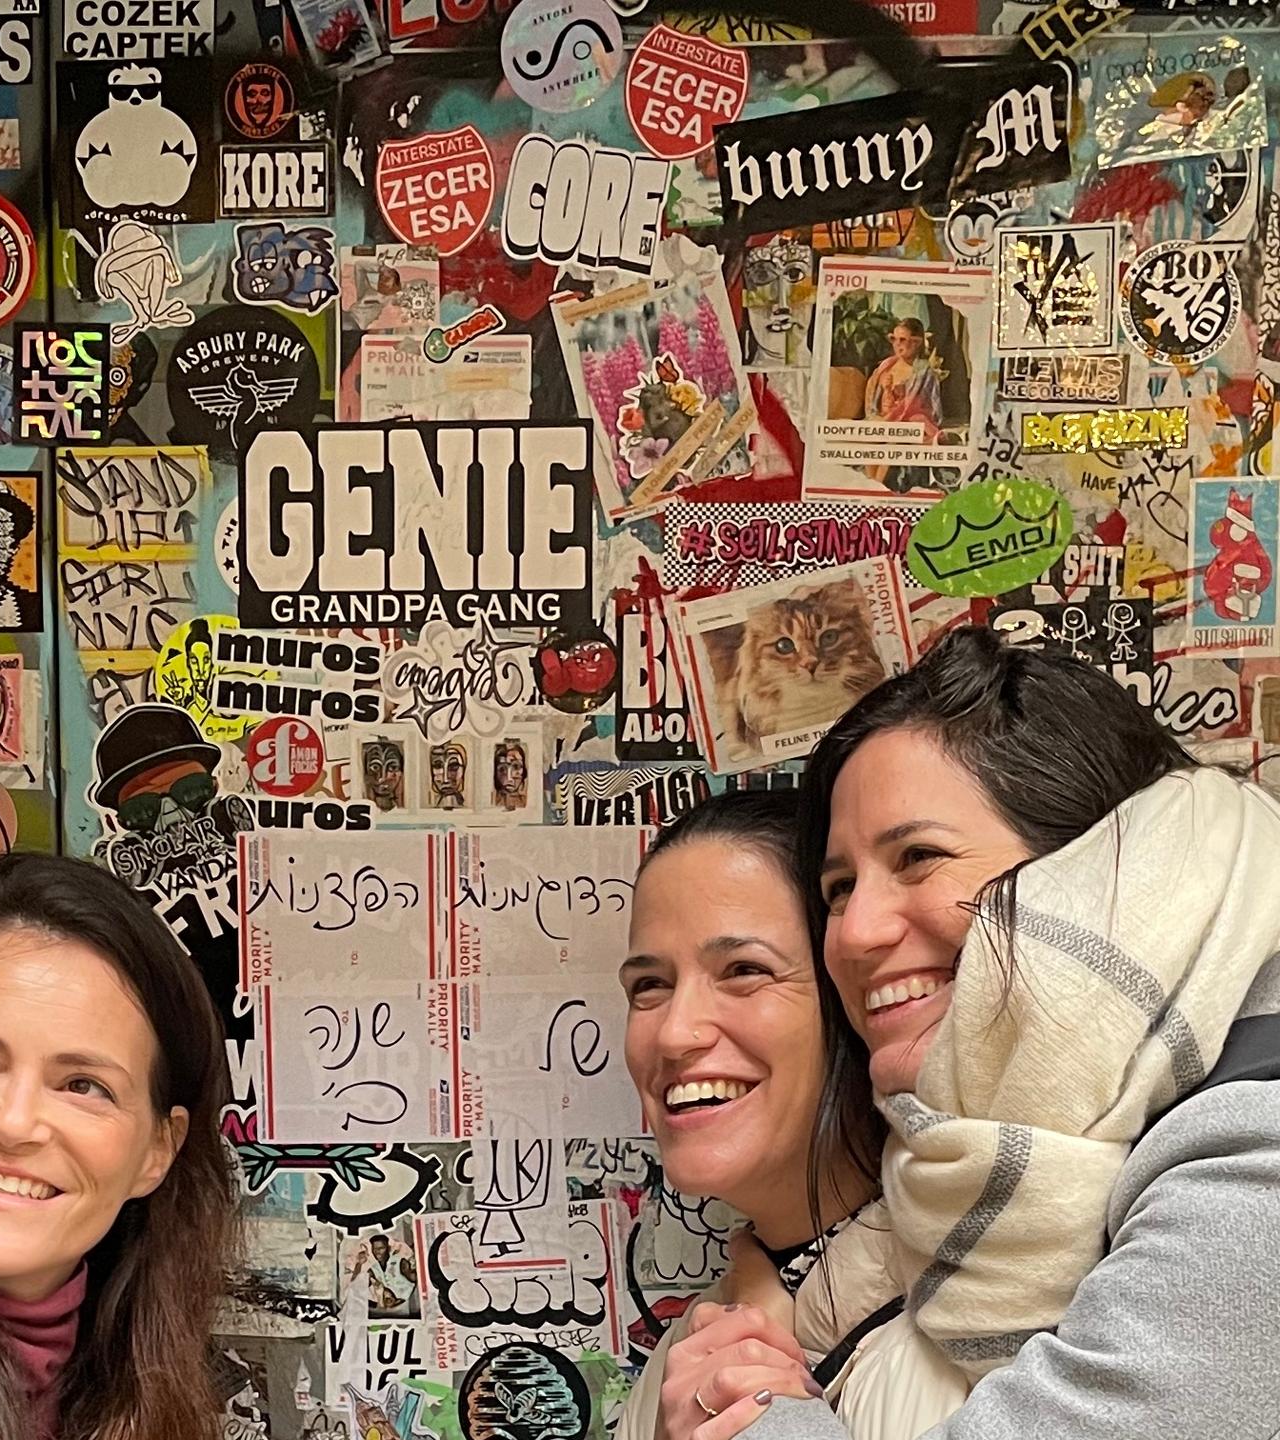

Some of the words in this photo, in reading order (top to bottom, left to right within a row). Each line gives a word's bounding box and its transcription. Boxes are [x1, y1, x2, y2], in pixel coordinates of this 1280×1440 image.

[76, 0, 200, 26] COZEK
[66, 33, 212, 59] CAPTEK
[652, 33, 741, 76] INTERSTATE
[631, 59, 734, 117] ZECER
[640, 104, 703, 143] ESA
[386, 136, 474, 165] INTERSTATE
[724, 123, 936, 206] bunny
[223, 152, 325, 209] KORE
[383, 164, 490, 211] ZECER
[409, 202, 476, 238] ESA
[509, 138, 668, 272] CORE
[176, 331, 251, 373] ASBURY
[256, 331, 305, 363] PARK
[201, 355, 281, 374] BREWERY
[823, 425, 855, 437] DON'T
[858, 425, 886, 437] FEAR
[887, 426, 921, 439] BEING
[820, 448, 886, 461] SWALLOWED
[888, 449, 902, 461] UP
[903, 450, 917, 461] BY
[920, 450, 941, 461] THE
[945, 450, 968, 462] SEA
[245, 428, 587, 593] GENIE
[967, 524, 1045, 563] EMO
[1066, 547, 1124, 586] SHIT
[271, 594, 444, 622] GRANDPA
[457, 594, 561, 621] GANG
[872, 562, 898, 637] PRIORITY
[216, 632, 382, 674] muros
[216, 679, 382, 722] muros
[775, 733, 809, 748] FELINE
[252, 800, 372, 831] uros
[438, 983, 448, 1053] PRIORITY
[462, 1069, 471, 1137] PRIORITY
